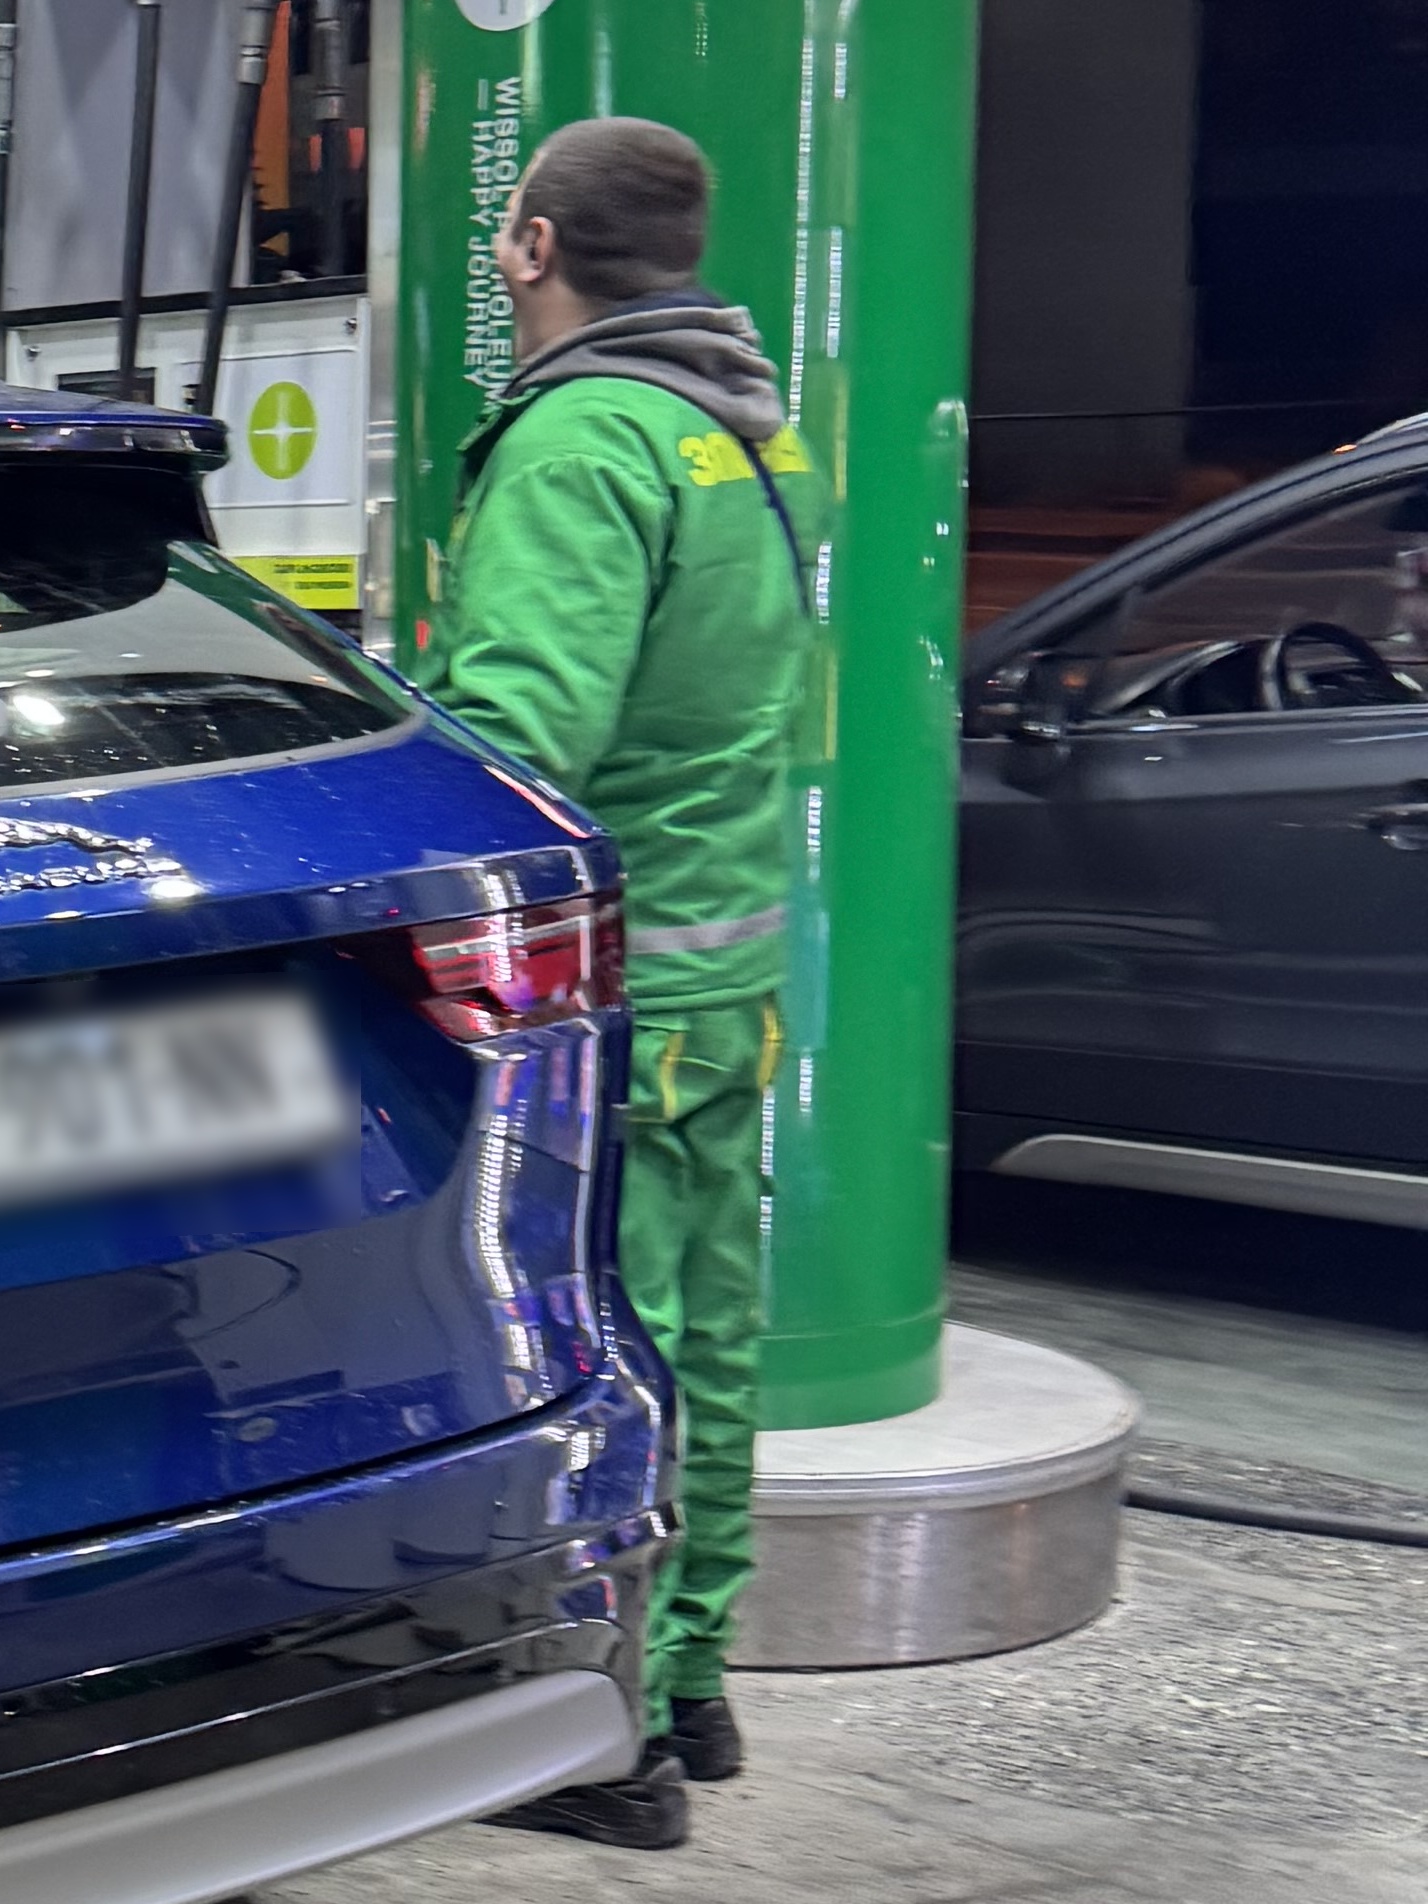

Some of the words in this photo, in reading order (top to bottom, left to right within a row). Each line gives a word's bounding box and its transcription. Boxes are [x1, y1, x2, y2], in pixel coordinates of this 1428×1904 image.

[469, 120, 495, 227] HAPPY
[494, 76, 522, 202] WISSOL
[463, 236, 492, 386] JOURNEY
